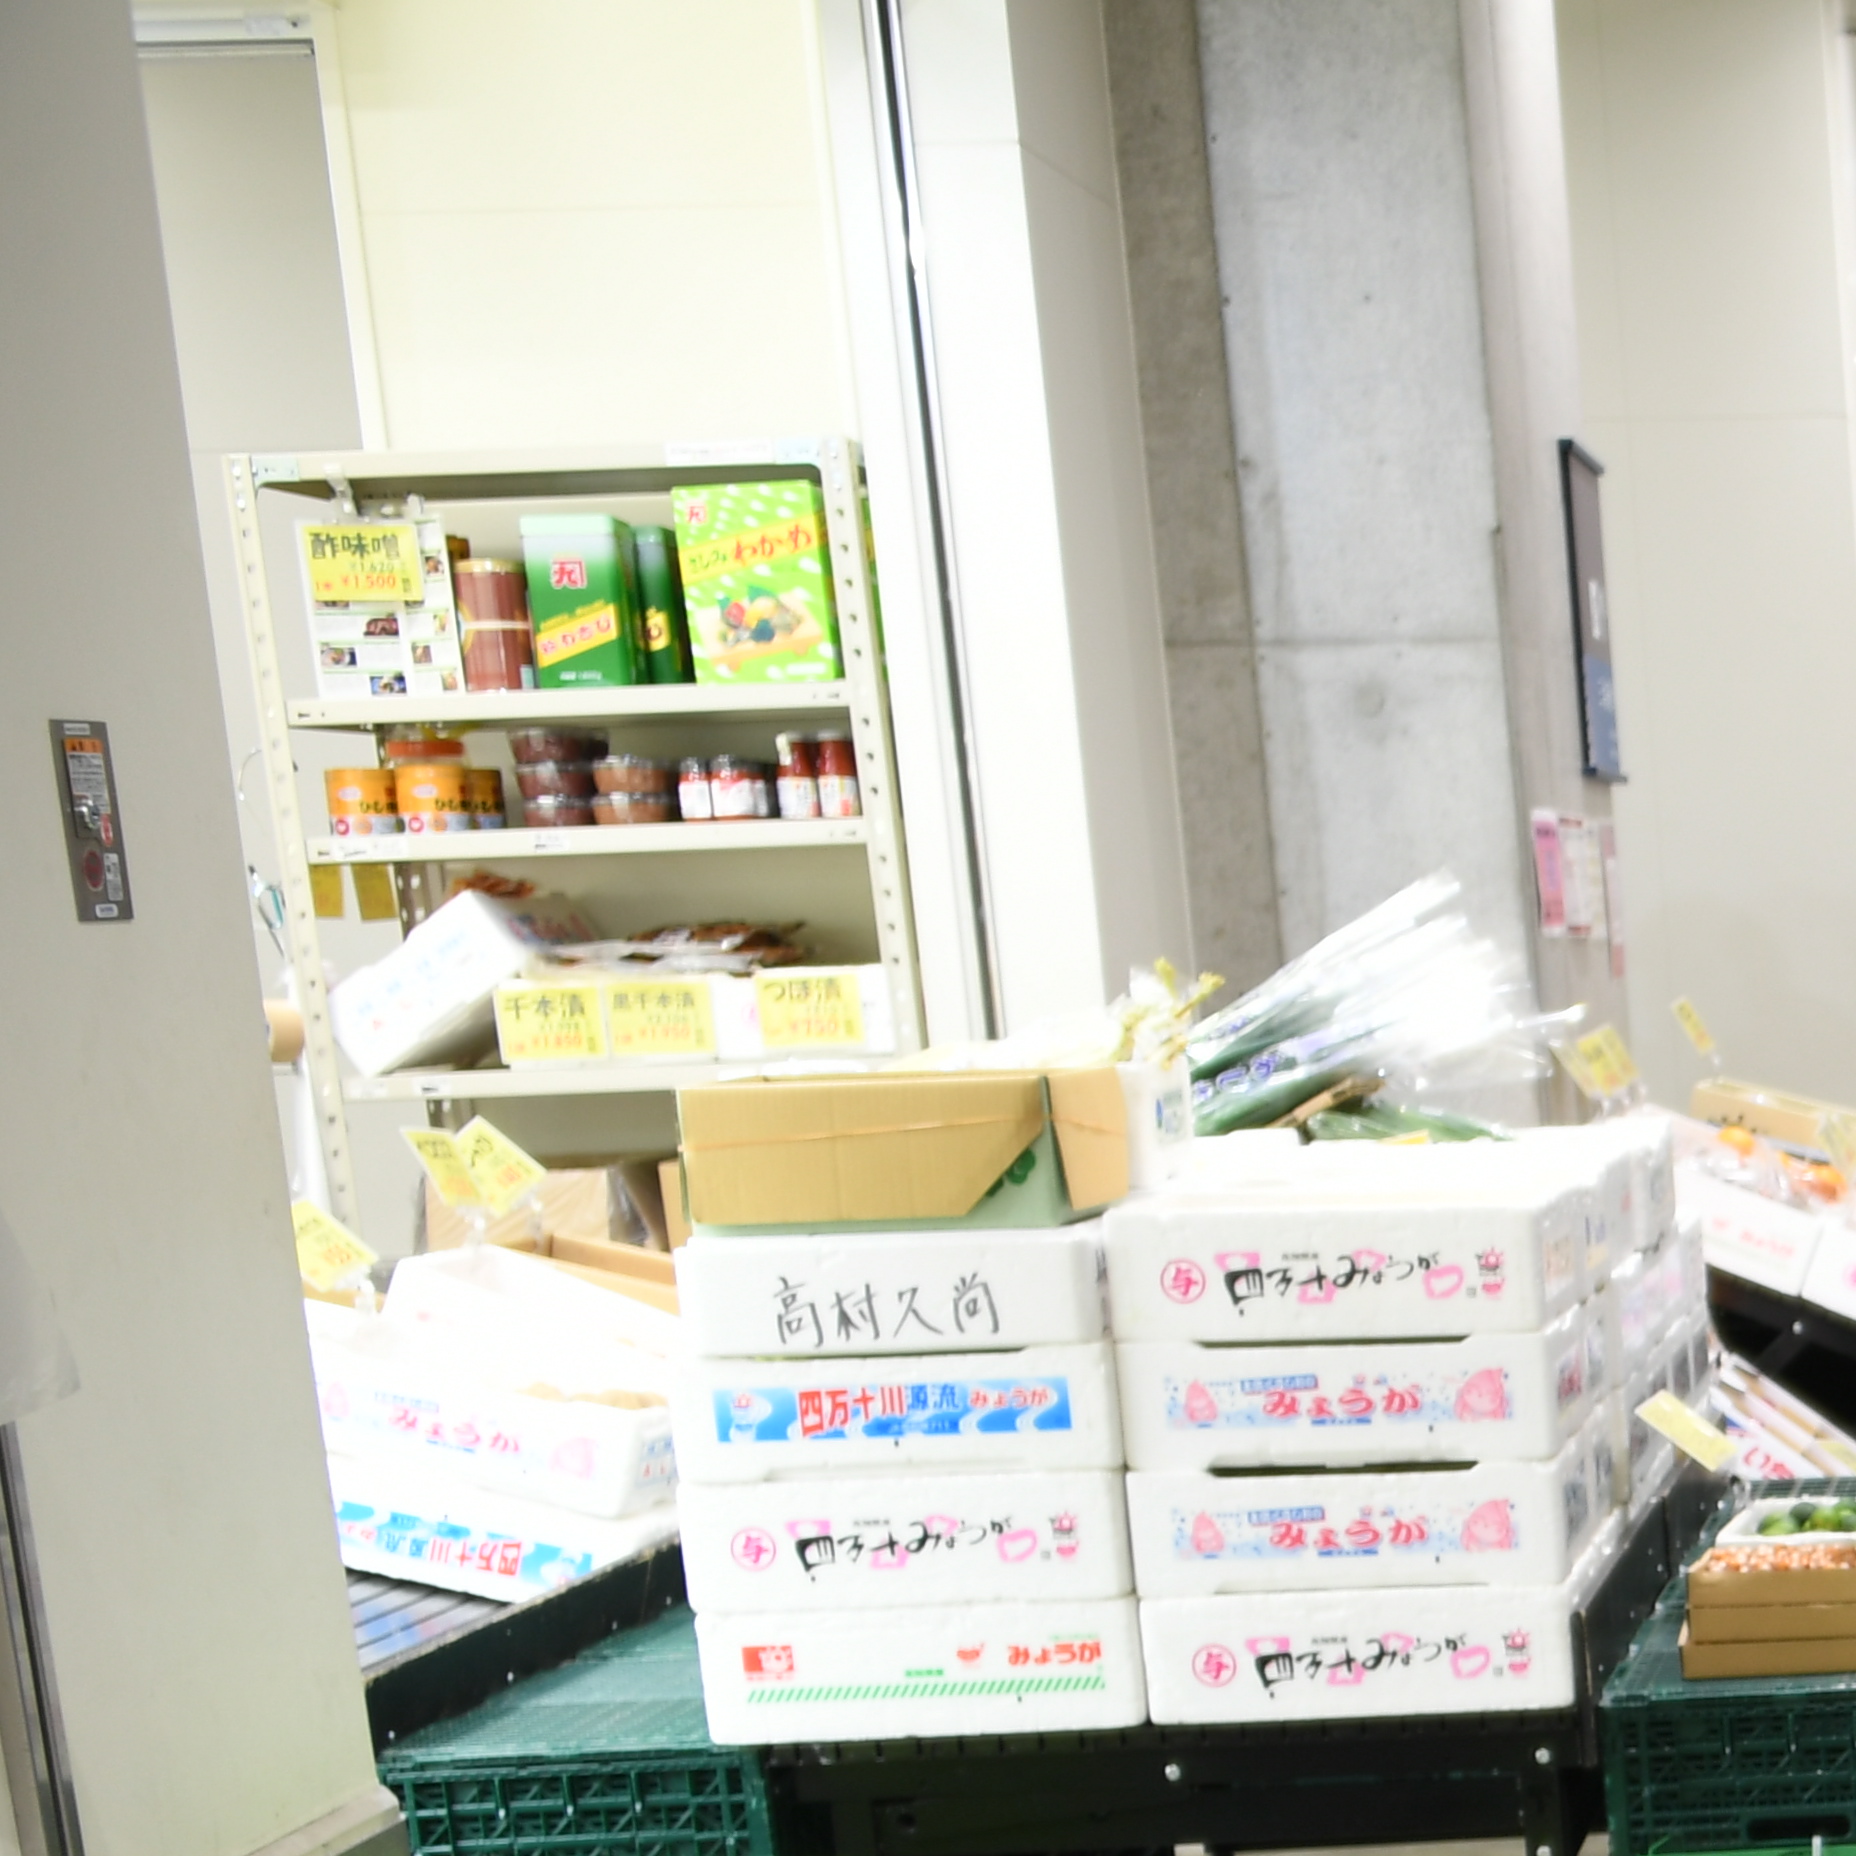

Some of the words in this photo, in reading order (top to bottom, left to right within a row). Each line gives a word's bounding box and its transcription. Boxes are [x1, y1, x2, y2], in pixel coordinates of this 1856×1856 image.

[733, 523, 813, 565] わかめ
[773, 1271, 1001, 1348] 高村久尚
[798, 1383, 962, 1438] 四万十川源流
[969, 1387, 1050, 1410] みょうが
[1263, 1384, 1422, 1420] みょうが
[389, 1407, 521, 1454] みょうが
[1269, 1515, 1428, 1551] みょうが
[1006, 1642, 1103, 1667] みょうが
